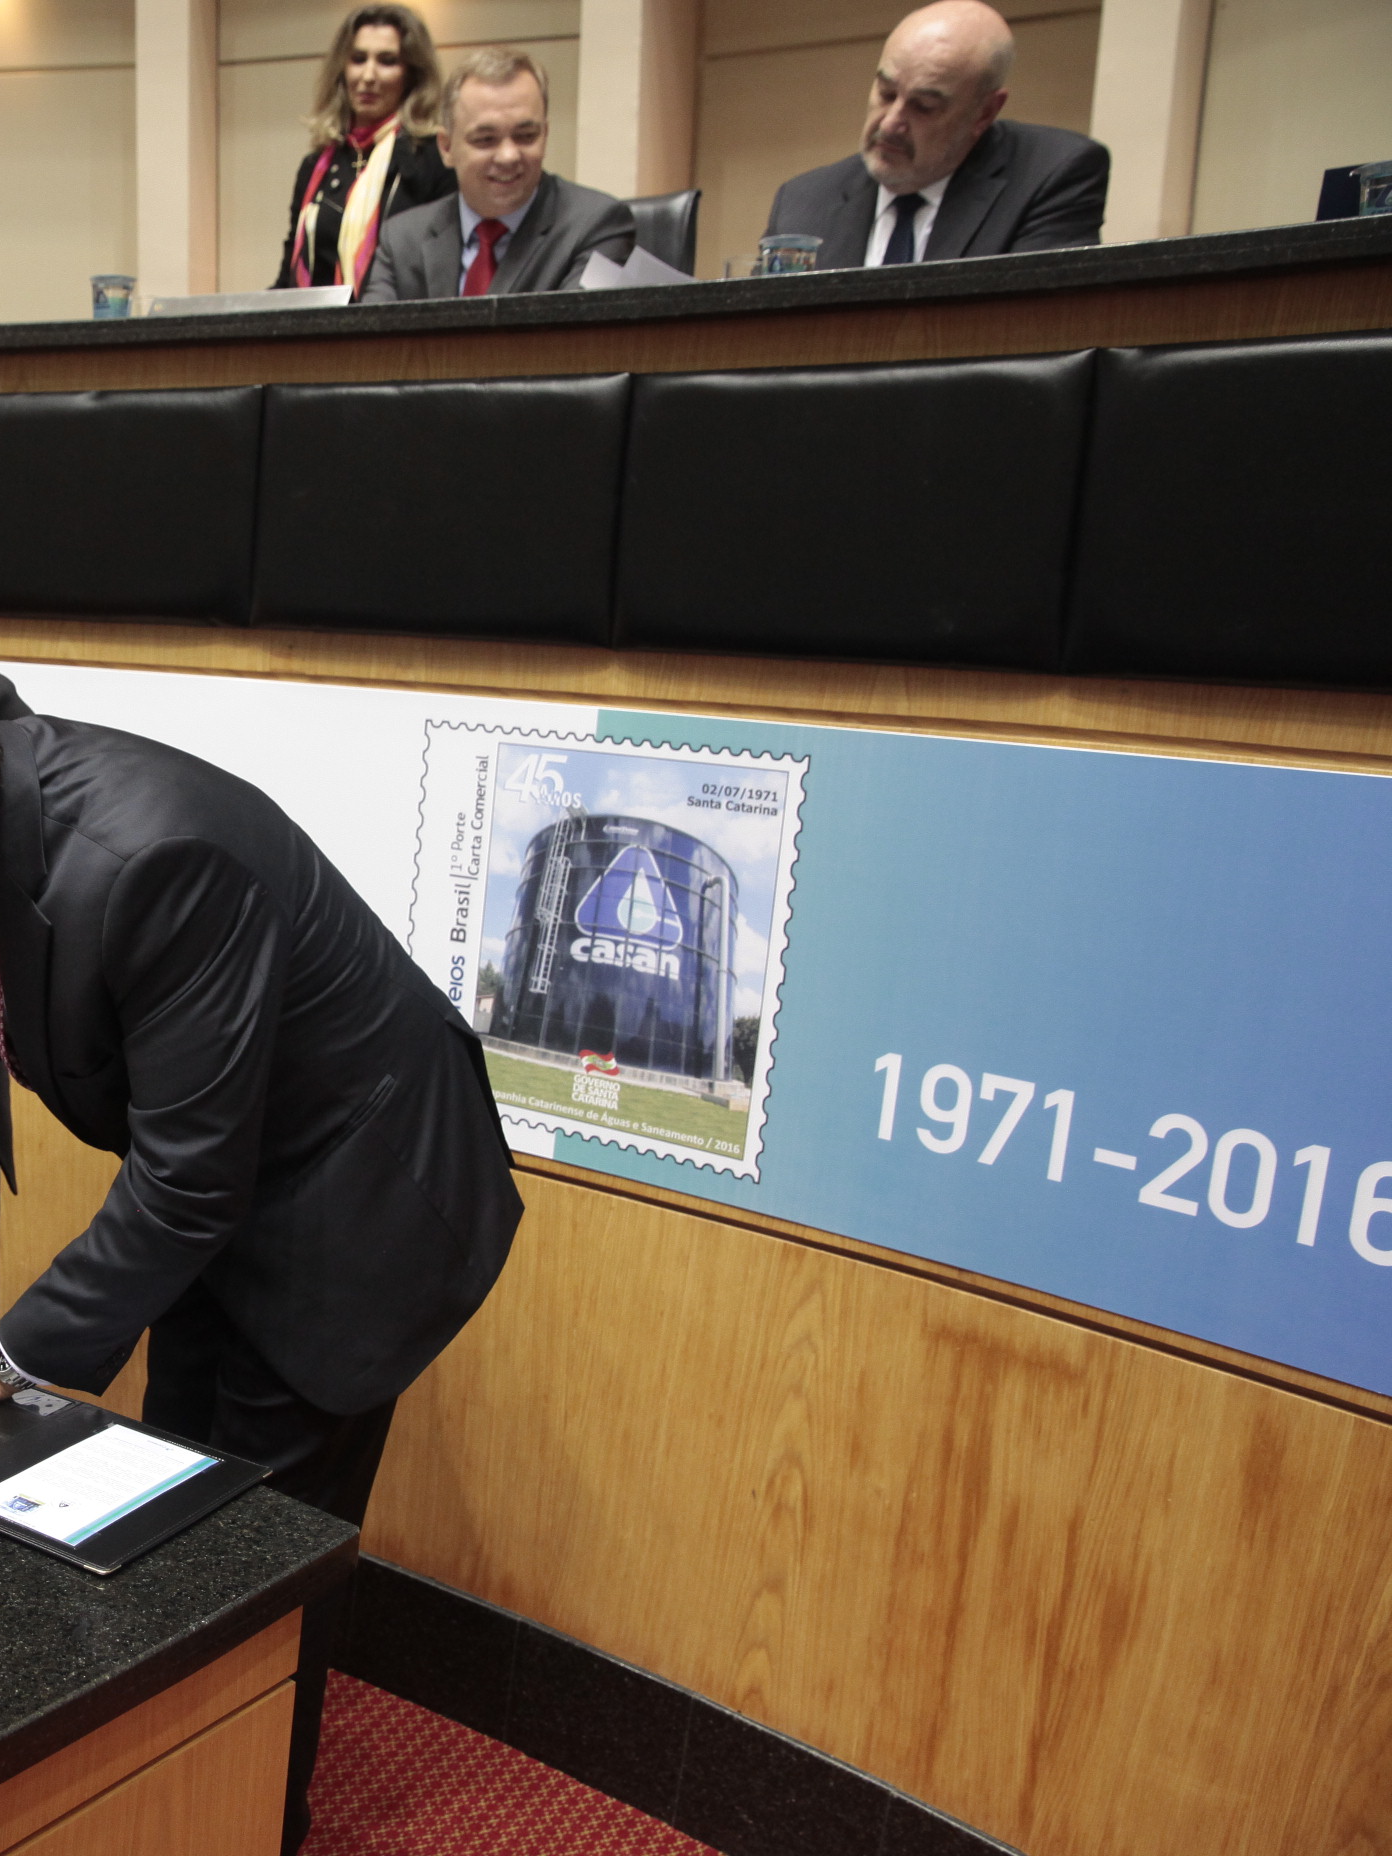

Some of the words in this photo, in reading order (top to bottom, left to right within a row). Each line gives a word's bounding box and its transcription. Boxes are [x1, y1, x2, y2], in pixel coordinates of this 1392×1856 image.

[470, 755, 490, 831] Comercial
[504, 753, 568, 804] 45
[702, 783, 779, 803] 02/07/1971
[687, 795, 722, 810] Santa
[725, 800, 779, 817] Catarina
[451, 811, 466, 852] Porte
[467, 835, 483, 877] Carta
[450, 883, 472, 943] Brasil
[569, 937, 681, 981] casan
[571, 1091, 619, 1111] CATARINA
[572, 1082, 586, 1094] DE
[588, 1085, 620, 1102] SANTA
[573, 1073, 621, 1092] GOVERNO
[528, 1096, 584, 1118] Catarinense
[586, 1109, 599, 1120] de
[601, 1110, 631, 1128] Águas
[632, 1122, 640, 1131] e
[641, 1121, 705, 1147] Saneamento
[714, 1139, 741, 1154] 2016
[873, 1052, 1392, 1267] 1971-2016
